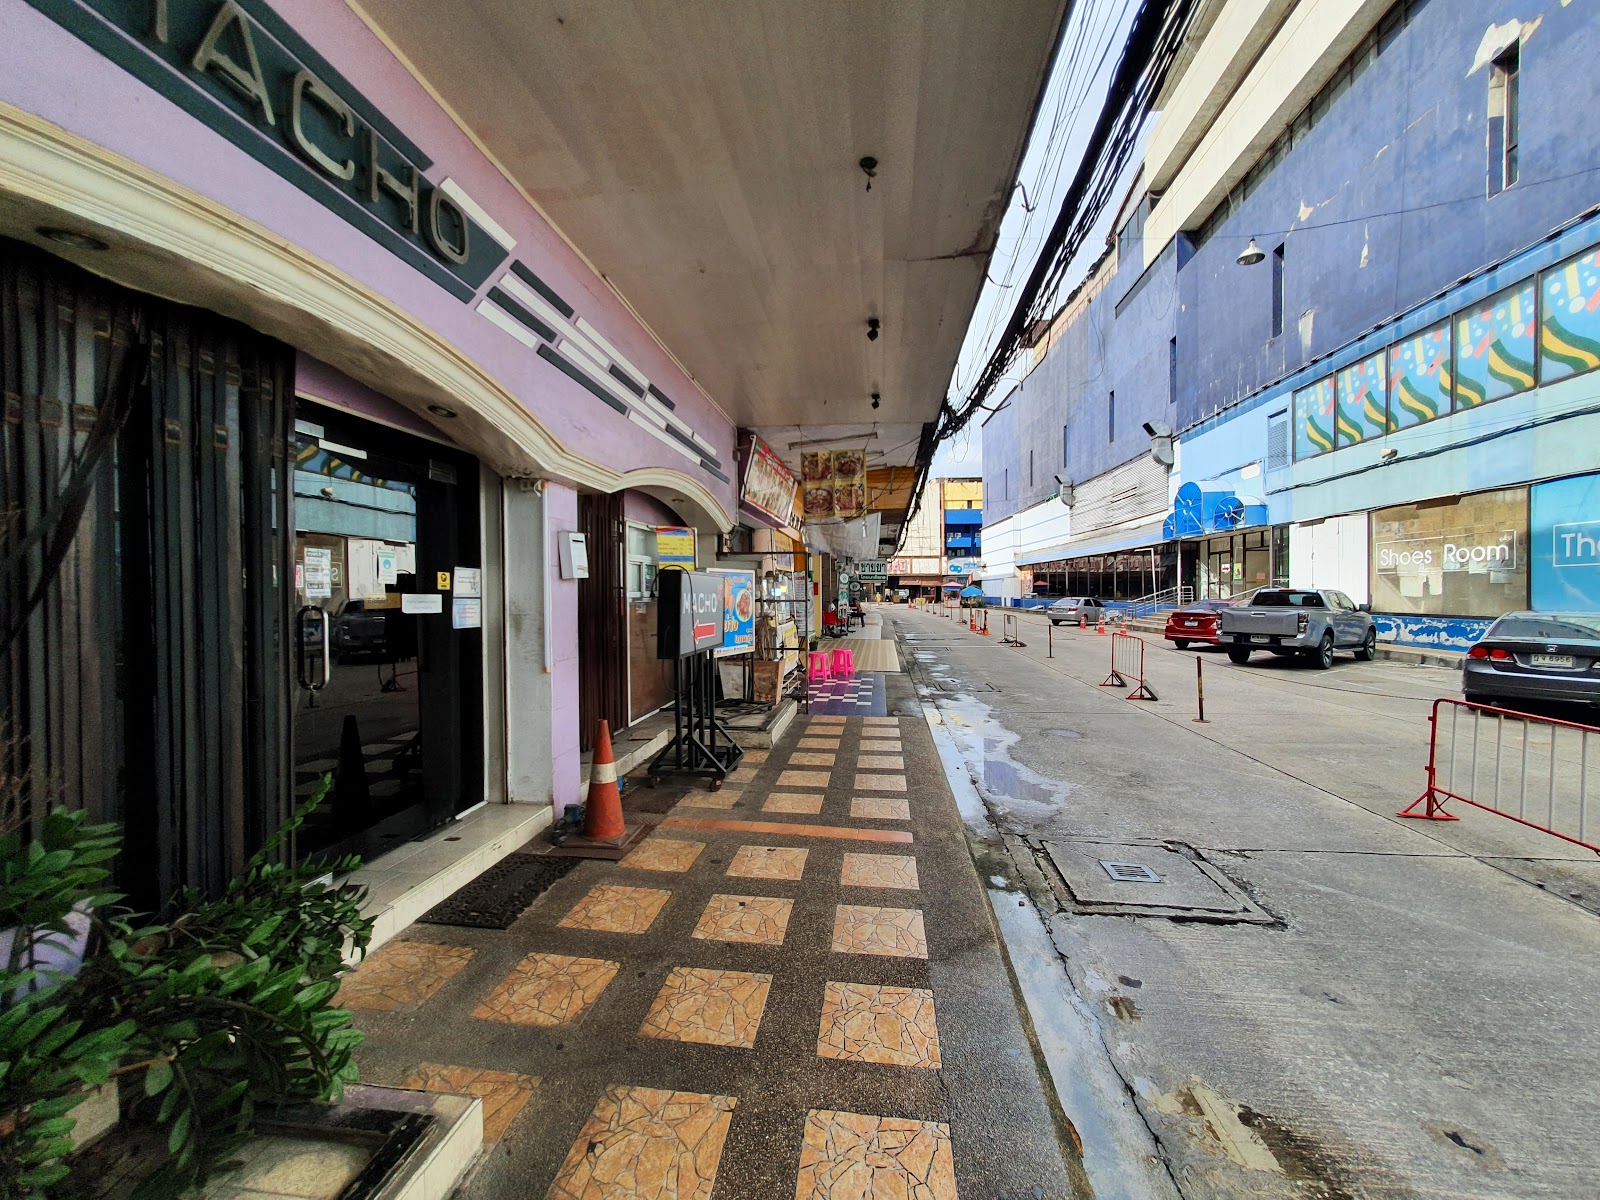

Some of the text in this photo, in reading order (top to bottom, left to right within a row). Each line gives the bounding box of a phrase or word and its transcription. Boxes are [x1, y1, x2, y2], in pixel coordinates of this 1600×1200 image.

[156, 0, 470, 265] ACHO
[1380, 543, 1510, 567] Shoes Room
[1560, 532, 1600, 558] Th
[860, 562, 886, 573] ขายยา
[682, 592, 718, 614] MACHO
